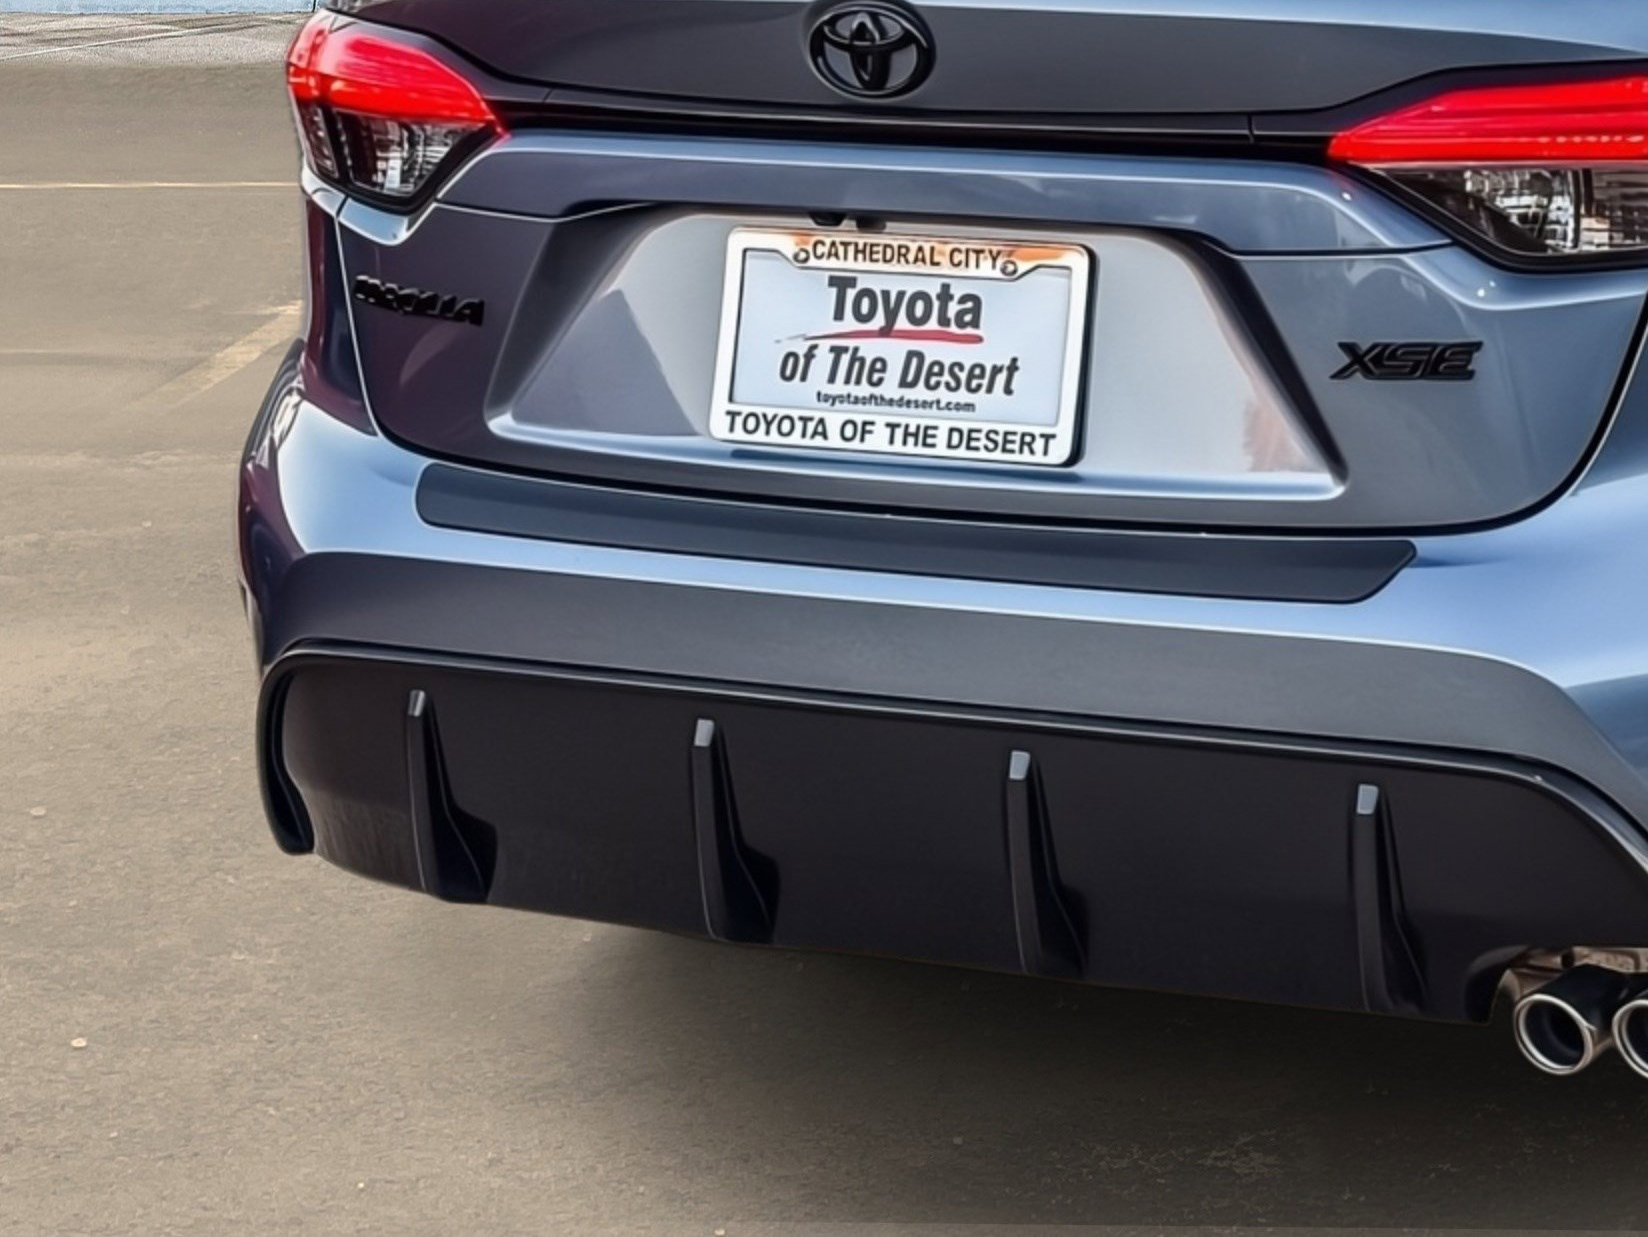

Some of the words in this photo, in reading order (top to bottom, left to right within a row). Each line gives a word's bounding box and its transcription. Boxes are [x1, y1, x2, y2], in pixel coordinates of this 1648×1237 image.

[811, 239, 940, 268] CATHEDRAL
[949, 247, 1003, 270] CITY
[827, 275, 983, 337] Toyota
[779, 344, 819, 383] of
[826, 346, 887, 389] The
[900, 350, 1020, 396] Desert
[1329, 341, 1483, 381] XSE
[816, 390, 976, 413] toyotaofthedesert.com
[725, 410, 829, 442] TOYOTA
[839, 419, 876, 444] OF
[884, 422, 938, 449] THE
[945, 427, 1057, 457] DESERT
